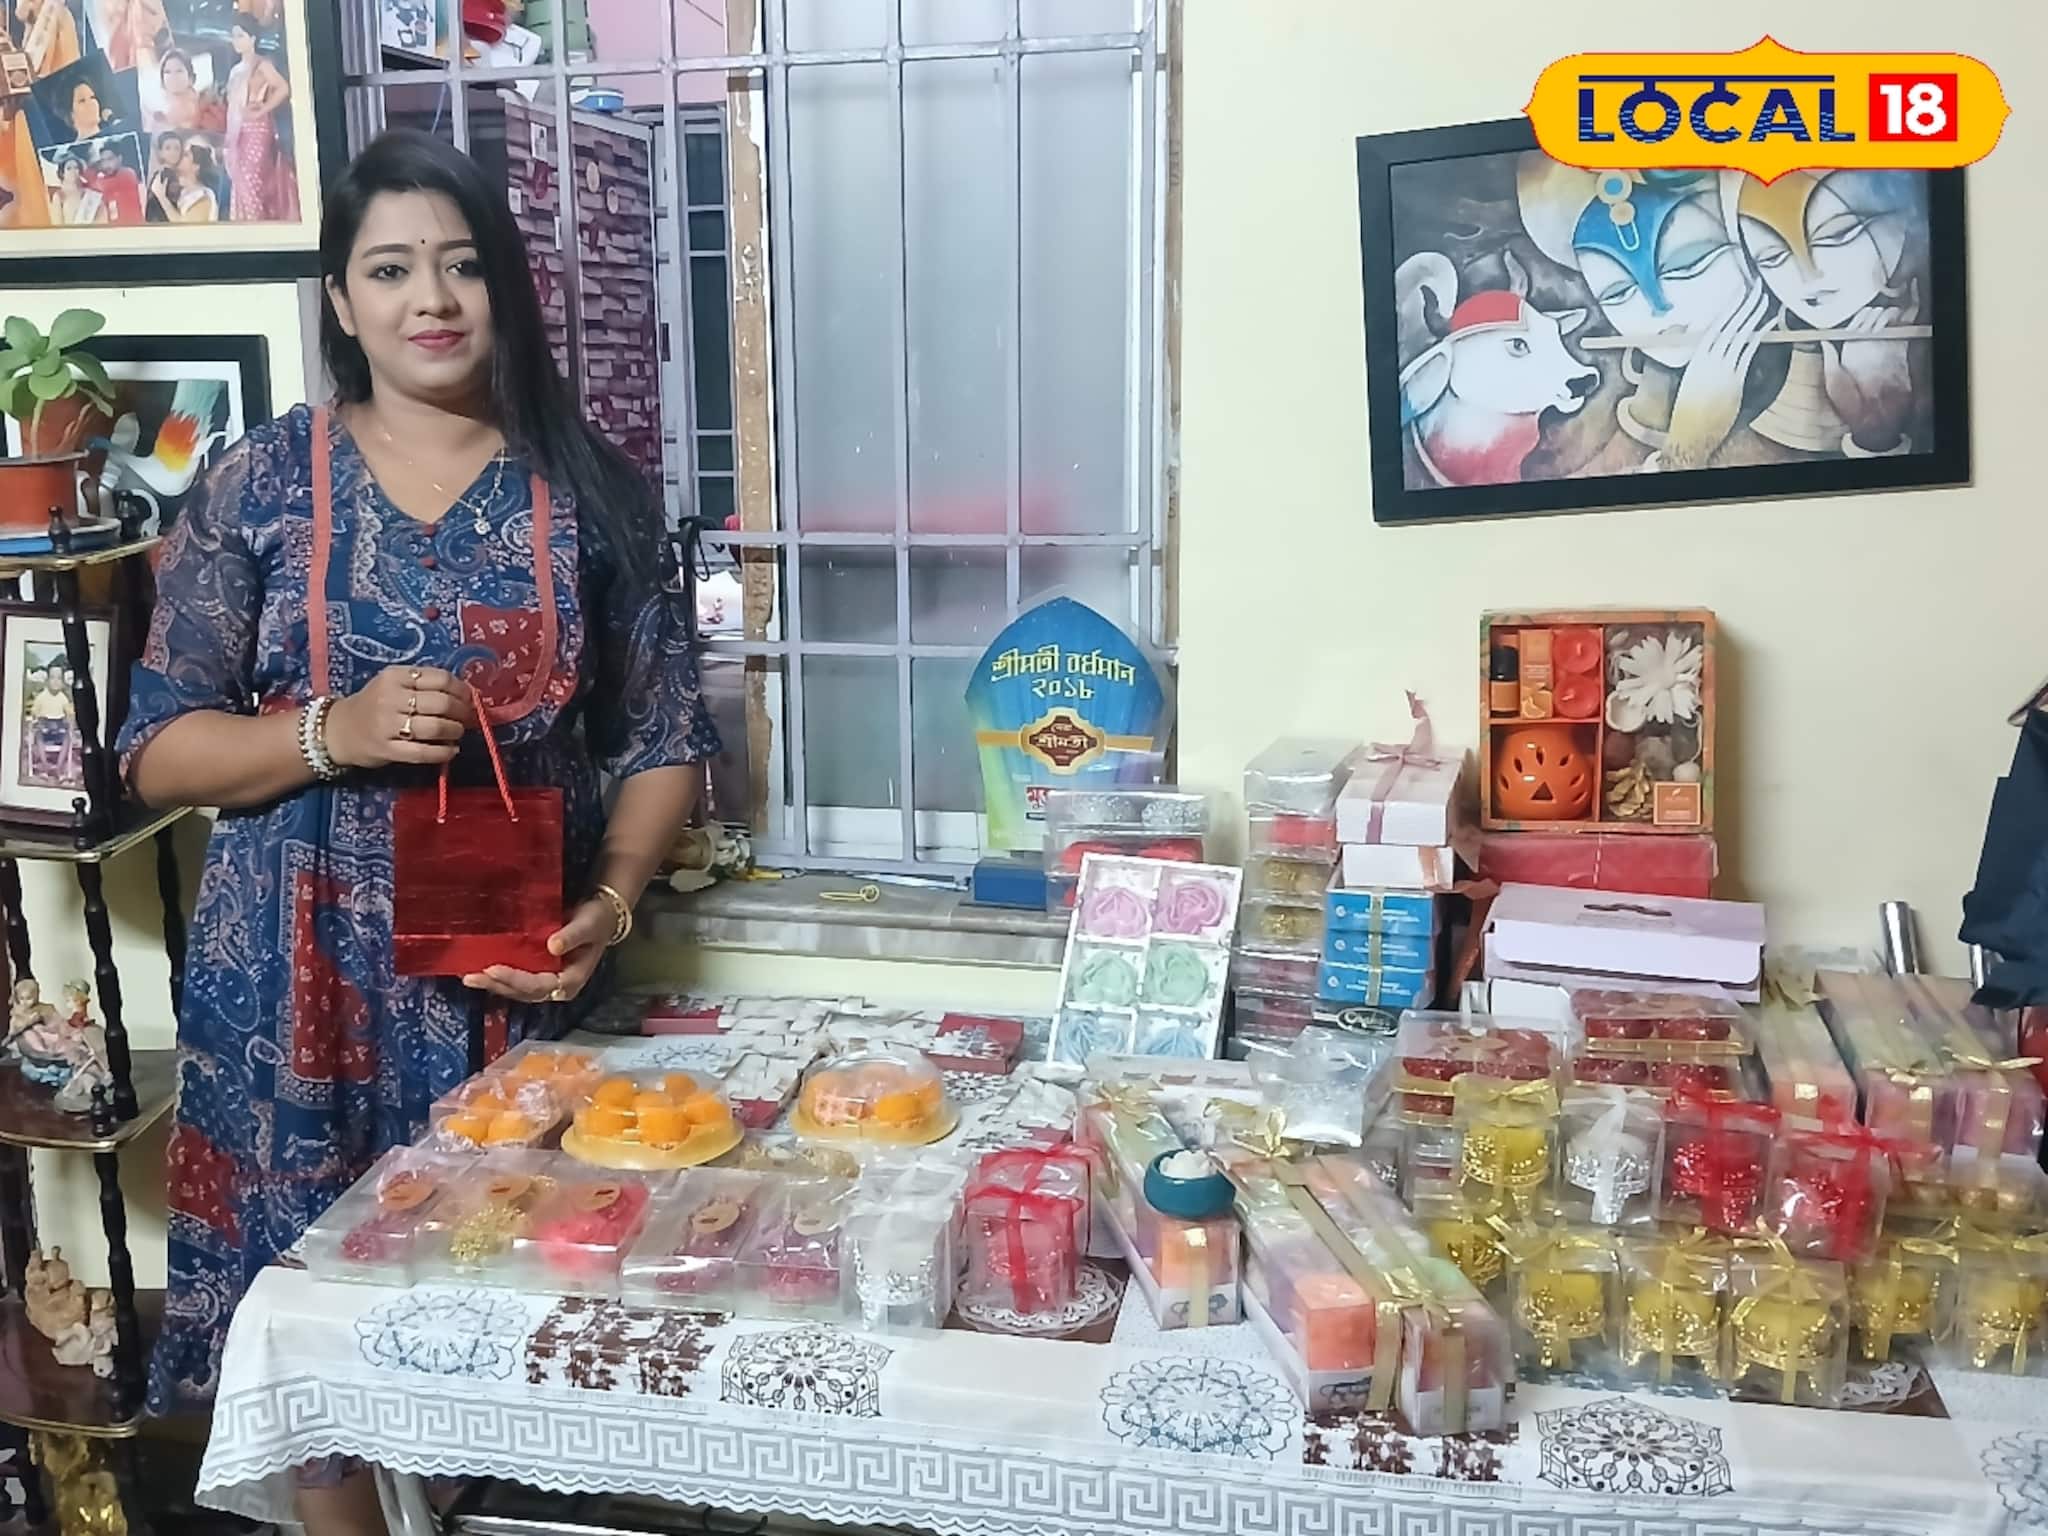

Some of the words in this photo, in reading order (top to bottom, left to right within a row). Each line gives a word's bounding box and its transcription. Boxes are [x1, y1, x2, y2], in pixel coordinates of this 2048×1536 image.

[991, 644, 1060, 682] শ্রীমতী
[1065, 649, 1136, 686] বর্ধমান
[1031, 677, 1095, 699] ২০১৮
